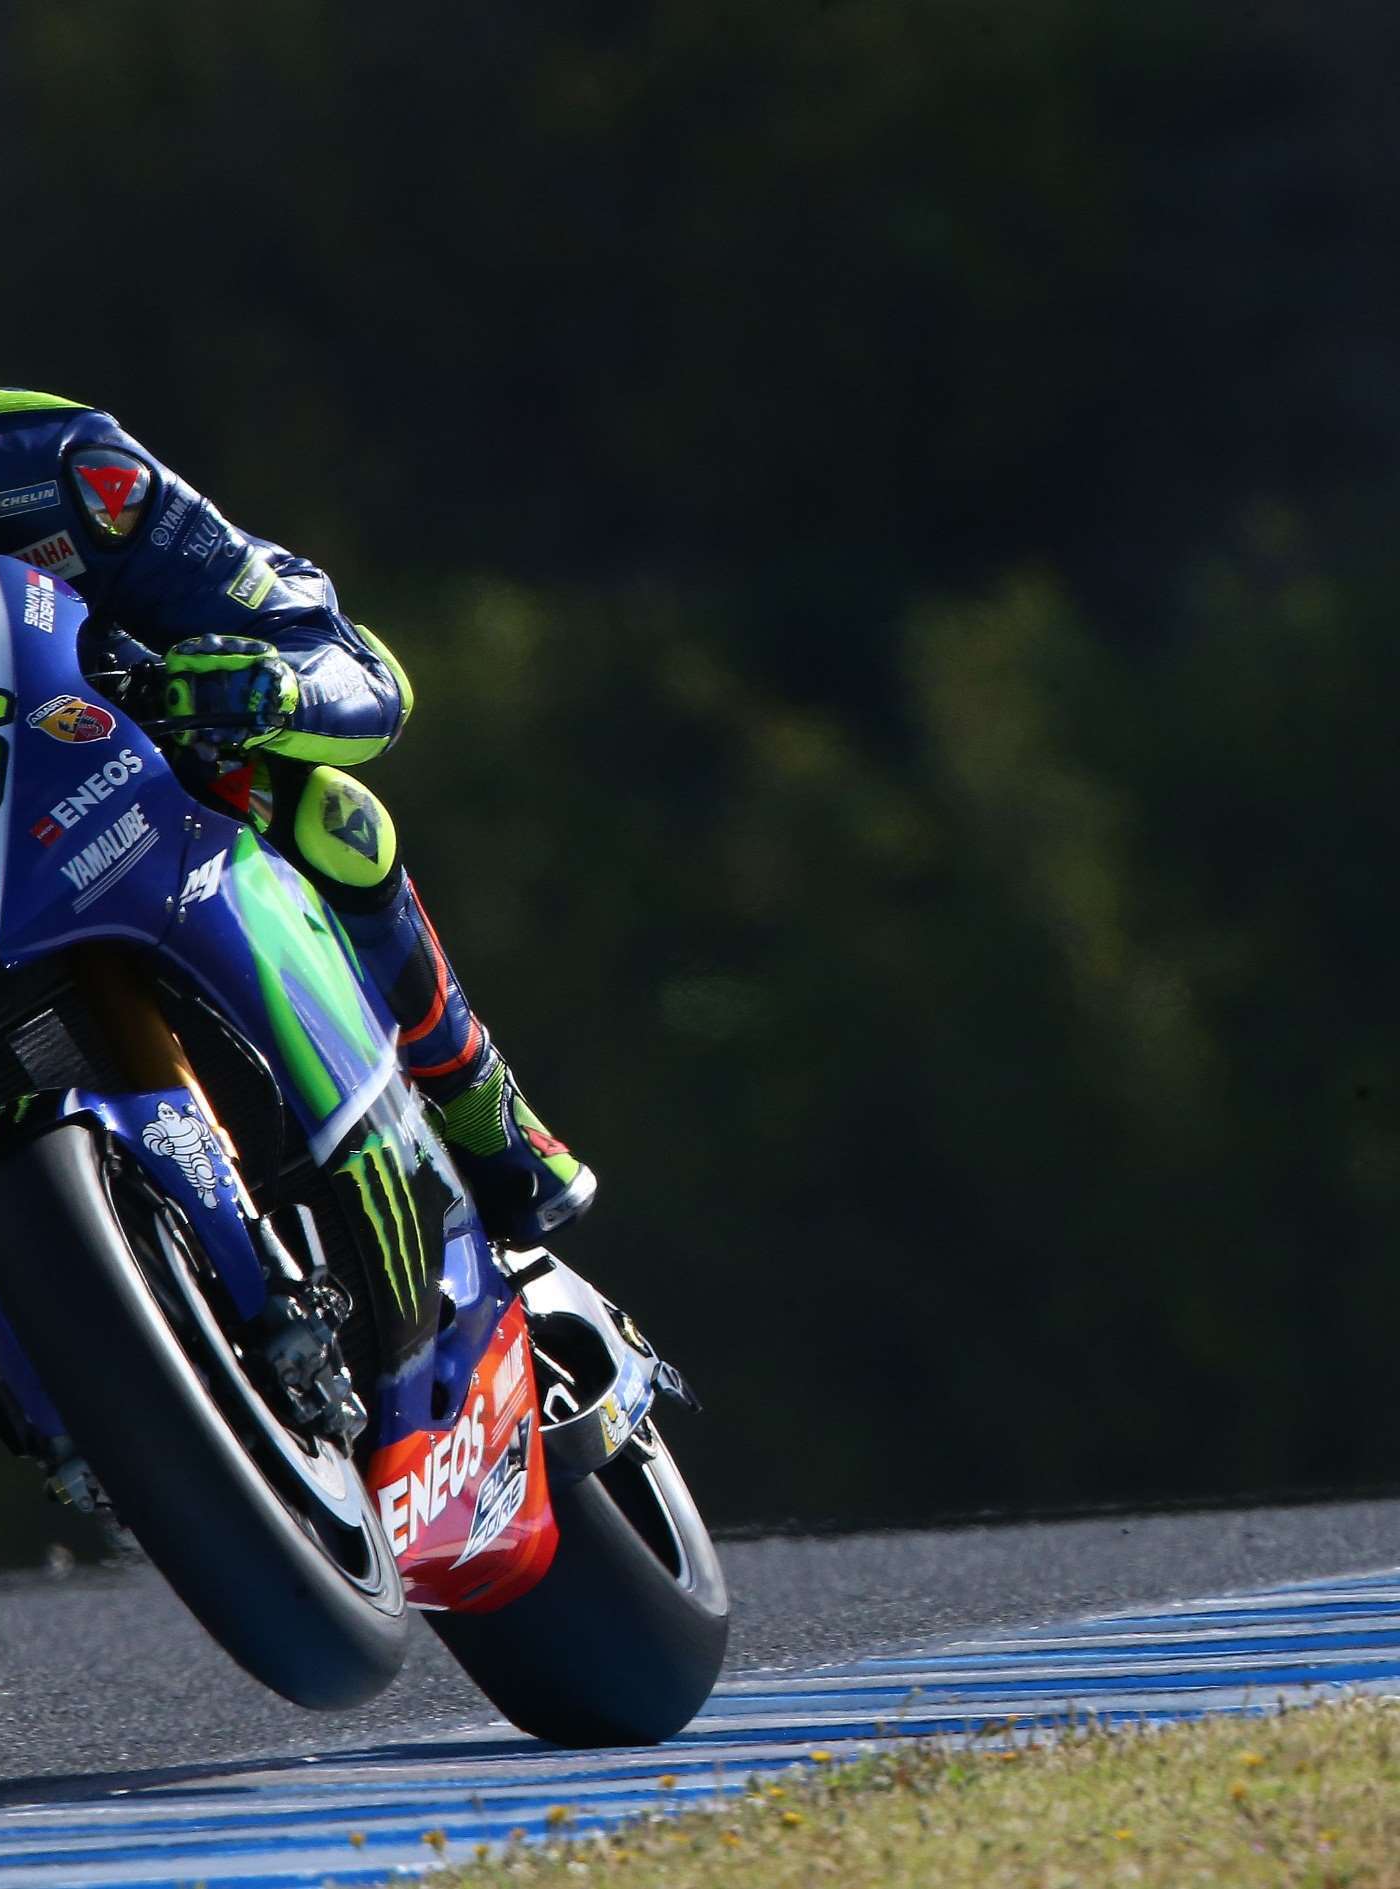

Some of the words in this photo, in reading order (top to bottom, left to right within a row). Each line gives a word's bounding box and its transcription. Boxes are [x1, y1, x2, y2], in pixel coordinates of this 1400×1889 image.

[50, 749, 143, 830] ENEOS
[60, 803, 150, 891] YAMALUBE
[377, 1394, 485, 1557] ENEOS
